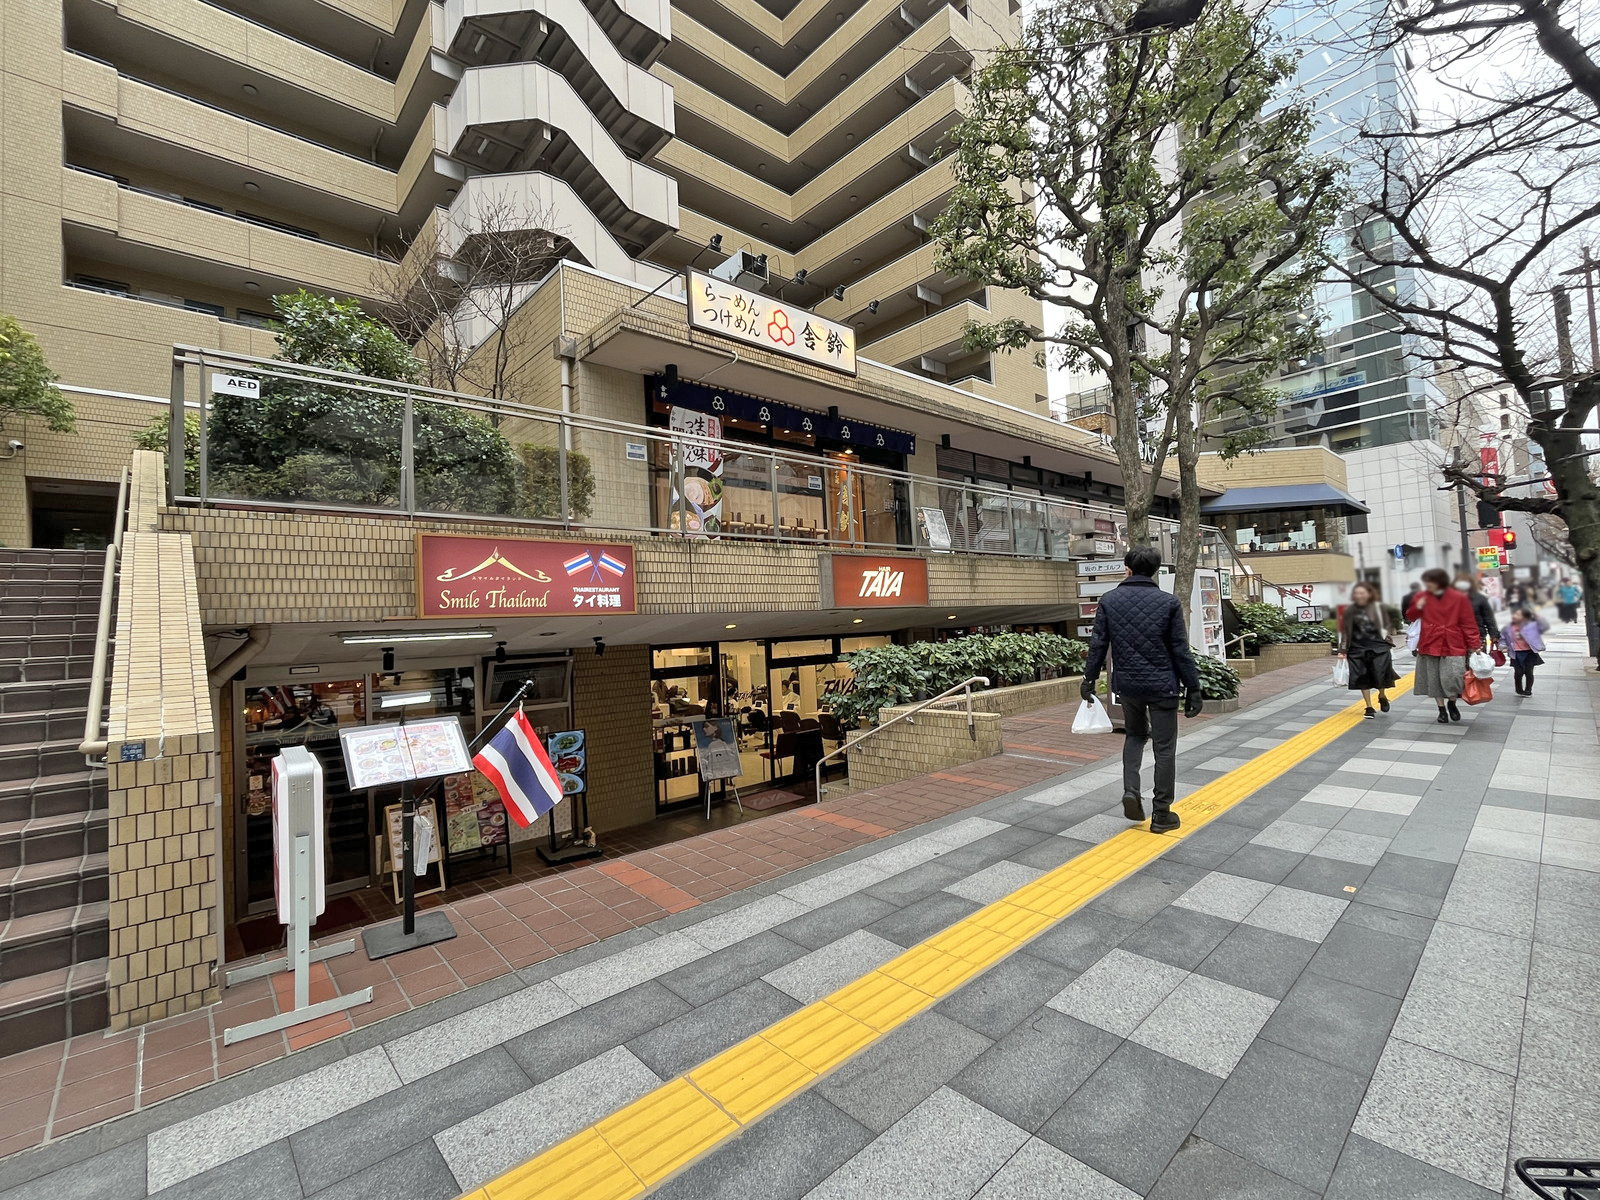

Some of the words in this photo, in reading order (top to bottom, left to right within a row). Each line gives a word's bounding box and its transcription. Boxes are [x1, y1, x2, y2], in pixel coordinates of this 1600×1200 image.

[704, 283, 761, 317] らーめん
[703, 307, 761, 338] つけめん
[799, 321, 849, 360] 舎鈴
[227, 378, 258, 390] AED
[1479, 547, 1496, 555] NPC
[858, 570, 905, 597] TAYA
[439, 590, 480, 609] Smile
[485, 585, 551, 609] Thailand
[572, 594, 622, 608] タイ料理
